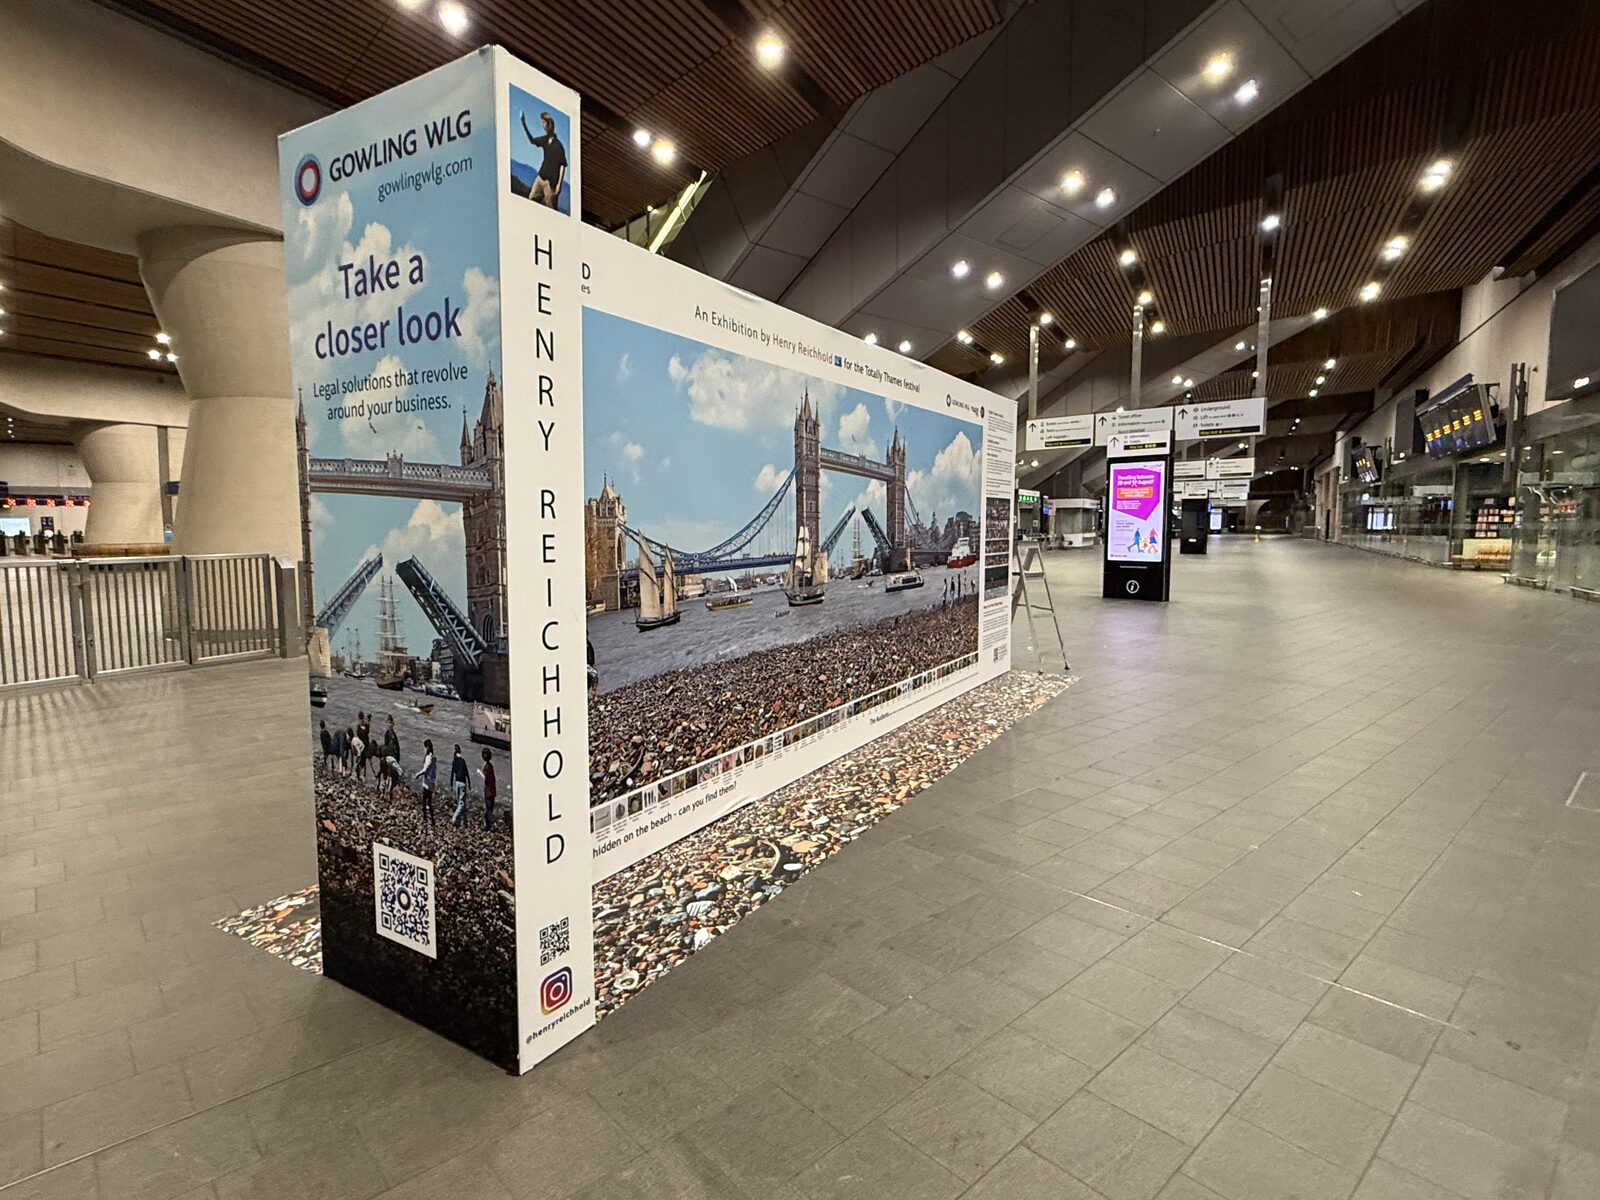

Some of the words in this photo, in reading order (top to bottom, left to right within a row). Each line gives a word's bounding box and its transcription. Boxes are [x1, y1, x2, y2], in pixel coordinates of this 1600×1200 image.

[329, 128, 417, 183] GOWLING
[425, 109, 472, 150] WLG
[377, 156, 473, 202] gowlingwlg.com
[338, 254, 400, 300] Take
[408, 254, 424, 285] a
[315, 318, 390, 359] closer
[398, 297, 462, 346] look
[695, 304, 709, 323] An
[711, 311, 758, 340] Exhibition
[760, 329, 771, 347] by
[773, 333, 796, 354] Henry
[797, 342, 833, 364] Reichhold
[843, 358, 852, 371] for
[854, 361, 864, 375] the
[865, 364, 883, 383] Totally
[884, 371, 903, 387] Thames
[313, 378, 340, 400] Legal
[341, 370, 392, 395] solutions
[394, 367, 419, 388] that
[421, 362, 468, 386] revolve
[327, 399, 365, 421] around
[367, 397, 393, 420] your
[396, 393, 452, 415] business.
[592, 838, 622, 859] hidden
[623, 833, 634, 844] on
[635, 824, 649, 838] the
[650, 811, 672, 830] beach
[678, 804, 691, 817] can
[691, 799, 704, 814] you
[705, 790, 718, 804] find
[525, 997, 591, 1045] @henryreichhold
